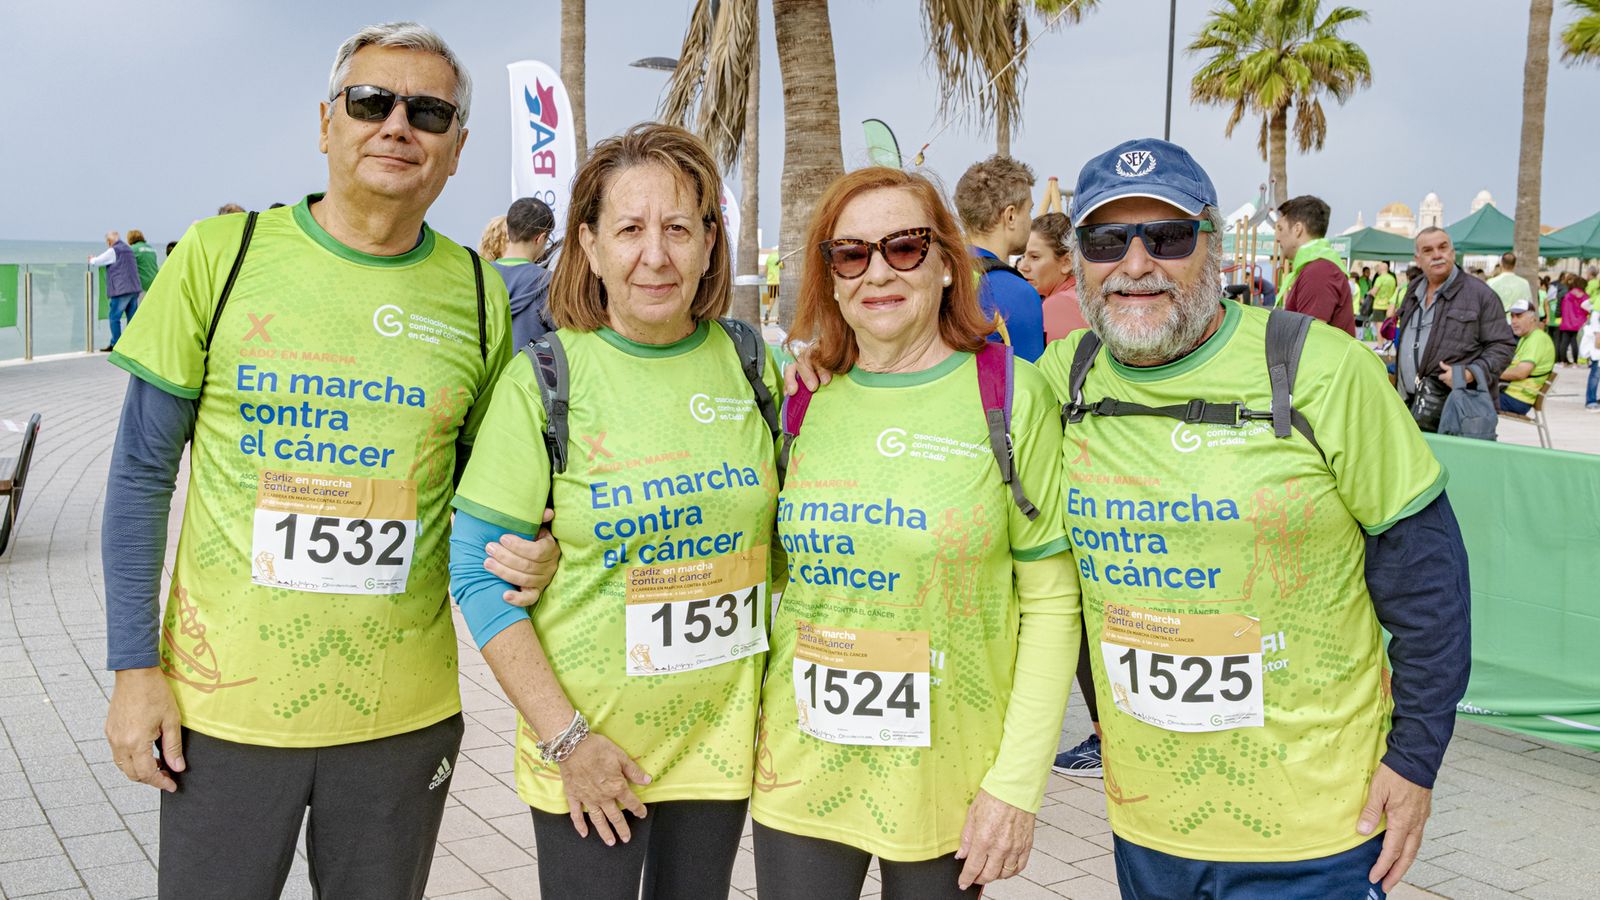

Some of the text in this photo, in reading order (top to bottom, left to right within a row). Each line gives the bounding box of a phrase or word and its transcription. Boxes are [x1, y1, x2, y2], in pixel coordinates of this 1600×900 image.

[1125, 152, 1146, 166] SEK
[281, 350, 297, 360] EN
[302, 351, 356, 365] MARCHA
[237, 365, 426, 408] En marcha
[240, 401, 349, 431] contra
[240, 429, 395, 468] el cáncer
[912, 441, 939, 451] contra
[913, 433, 958, 445] asociación
[1220, 436, 1246, 446] Cádiz
[923, 450, 946, 462] Cádiz
[264, 482, 297, 493] contra
[300, 484, 310, 494] el
[295, 477, 309, 485] en
[311, 478, 352, 489] marcha
[590, 462, 760, 509] En marcha
[800, 498, 927, 530] marcha
[1068, 488, 1240, 522] En marcha
[594, 505, 703, 541] contra
[275, 513, 407, 566] 1532
[603, 531, 743, 569] el cáncer
[780, 528, 855, 556] ontra
[1072, 527, 1168, 555] contra
[632, 576, 665, 586] contra
[667, 575, 677, 583] el
[663, 566, 676, 575] en
[678, 561, 713, 573] marcha
[801, 559, 900, 592] cáncer
[1080, 555, 1221, 589] el cáncer
[651, 585, 758, 647] 1531
[834, 605, 858, 614] CONTRA
[1131, 610, 1142, 619] en
[1144, 612, 1181, 625] marcha
[822, 630, 856, 640] marcha
[1107, 615, 1179, 635] contra el cáncer
[1120, 648, 1253, 703] 1525
[804, 663, 920, 719] 1524
